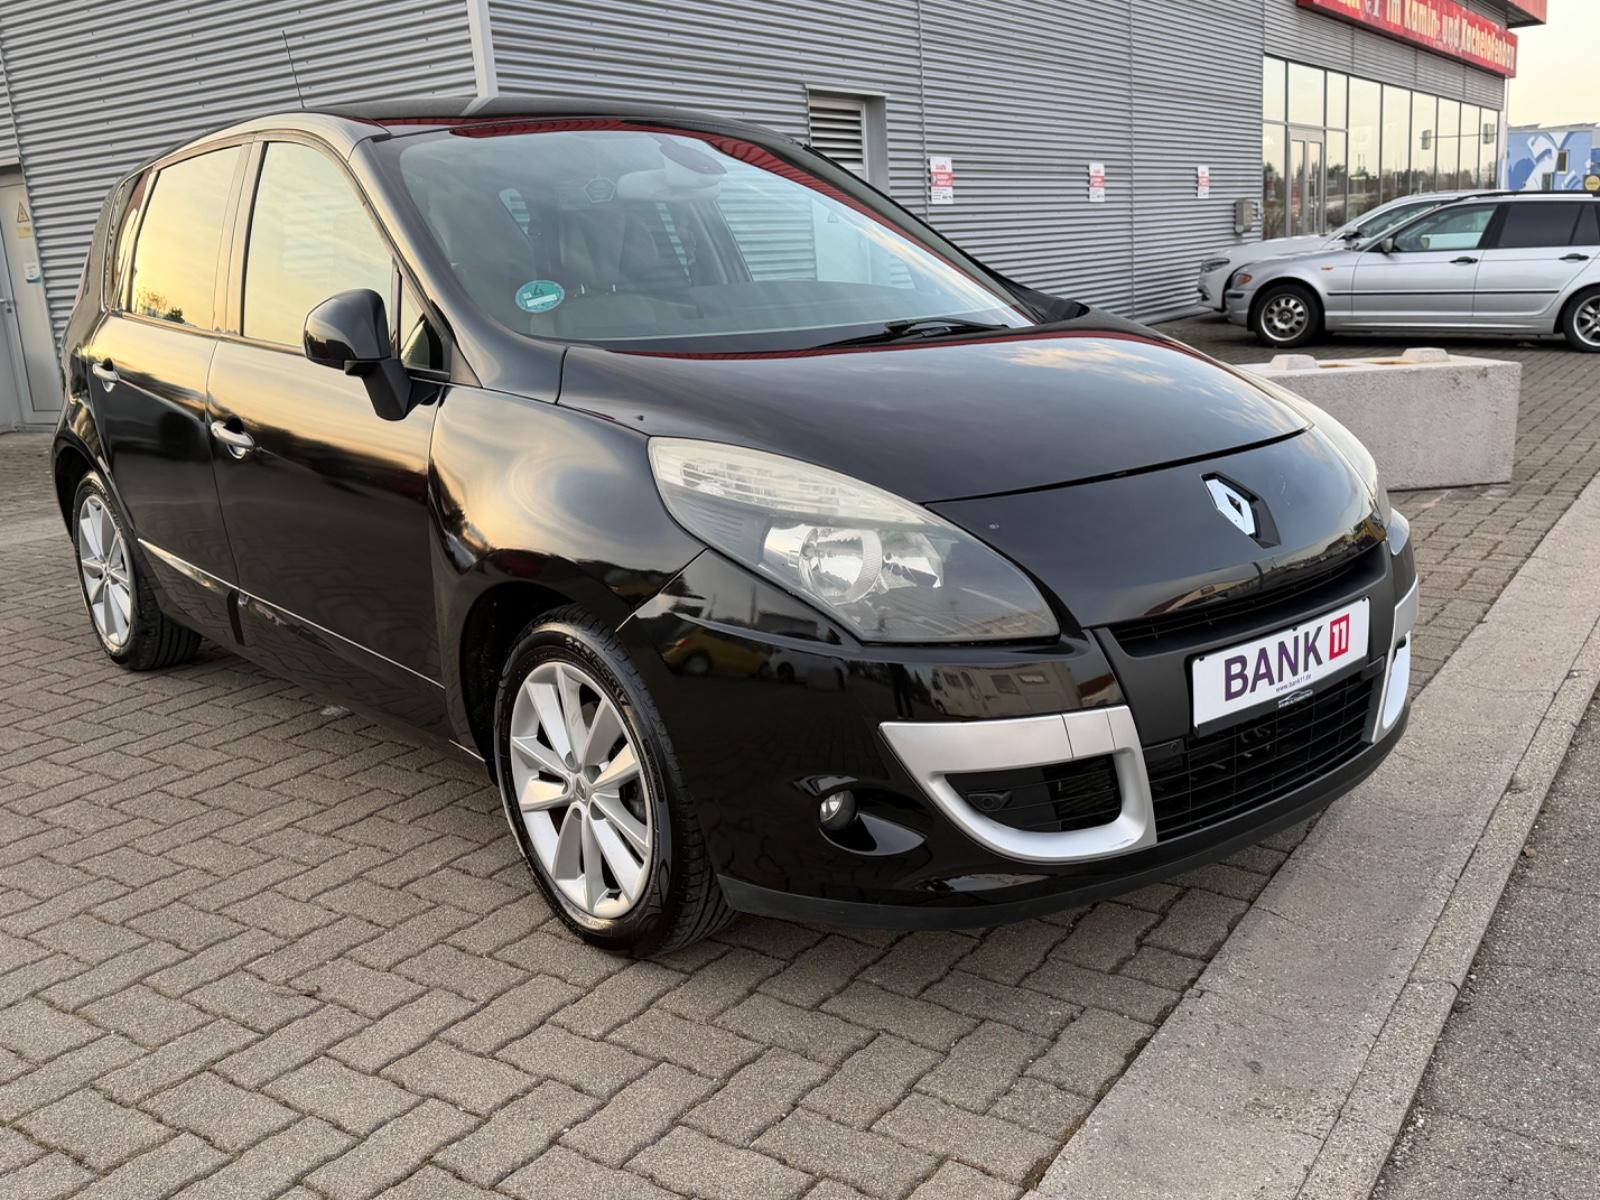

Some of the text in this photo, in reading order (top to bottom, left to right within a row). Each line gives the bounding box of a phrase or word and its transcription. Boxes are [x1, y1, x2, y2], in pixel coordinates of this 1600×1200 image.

[1224, 618, 1348, 702] BANK 11
[1275, 673, 1312, 693] www.bank11.de
